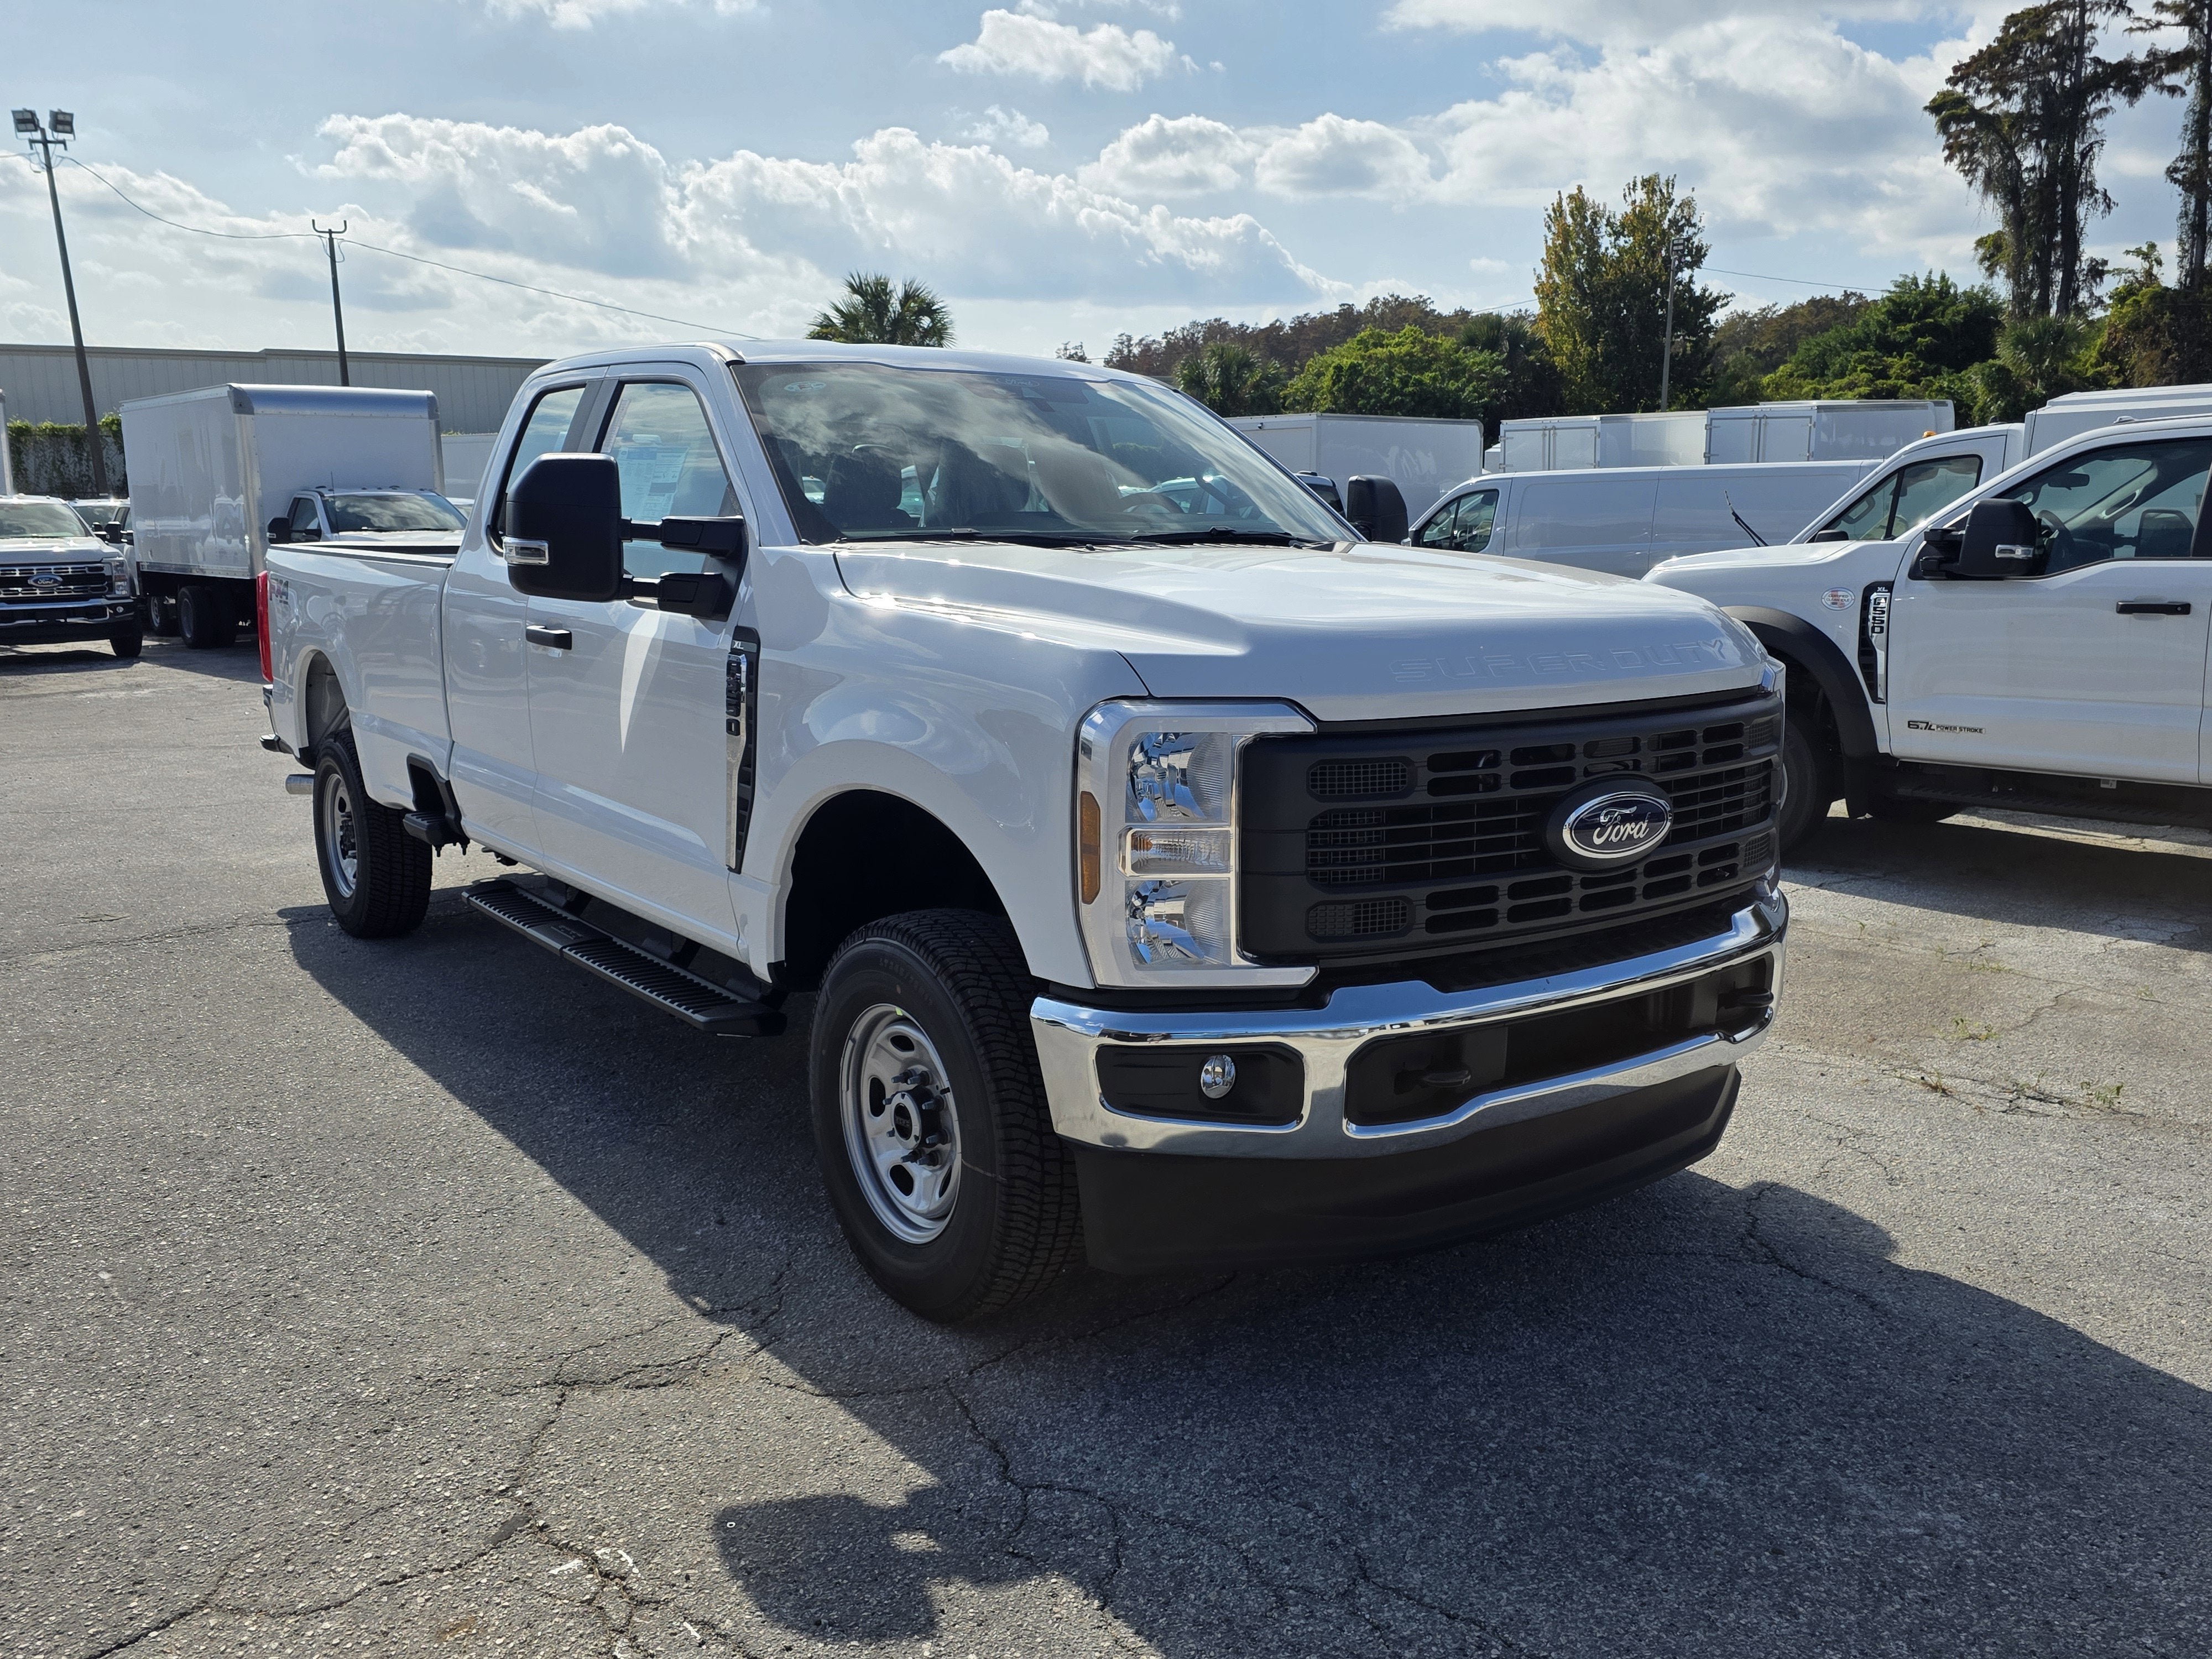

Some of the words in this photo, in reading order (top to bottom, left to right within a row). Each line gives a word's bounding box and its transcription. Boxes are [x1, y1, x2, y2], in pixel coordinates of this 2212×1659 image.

[269, 578, 289, 601] FX4
[733, 641, 744, 650] XL
[1389, 650, 1606, 682] SUPER
[1609, 639, 1726, 669] DUTY
[1908, 721, 1935, 731] 6.7L
[1593, 806, 1651, 845] Ford
